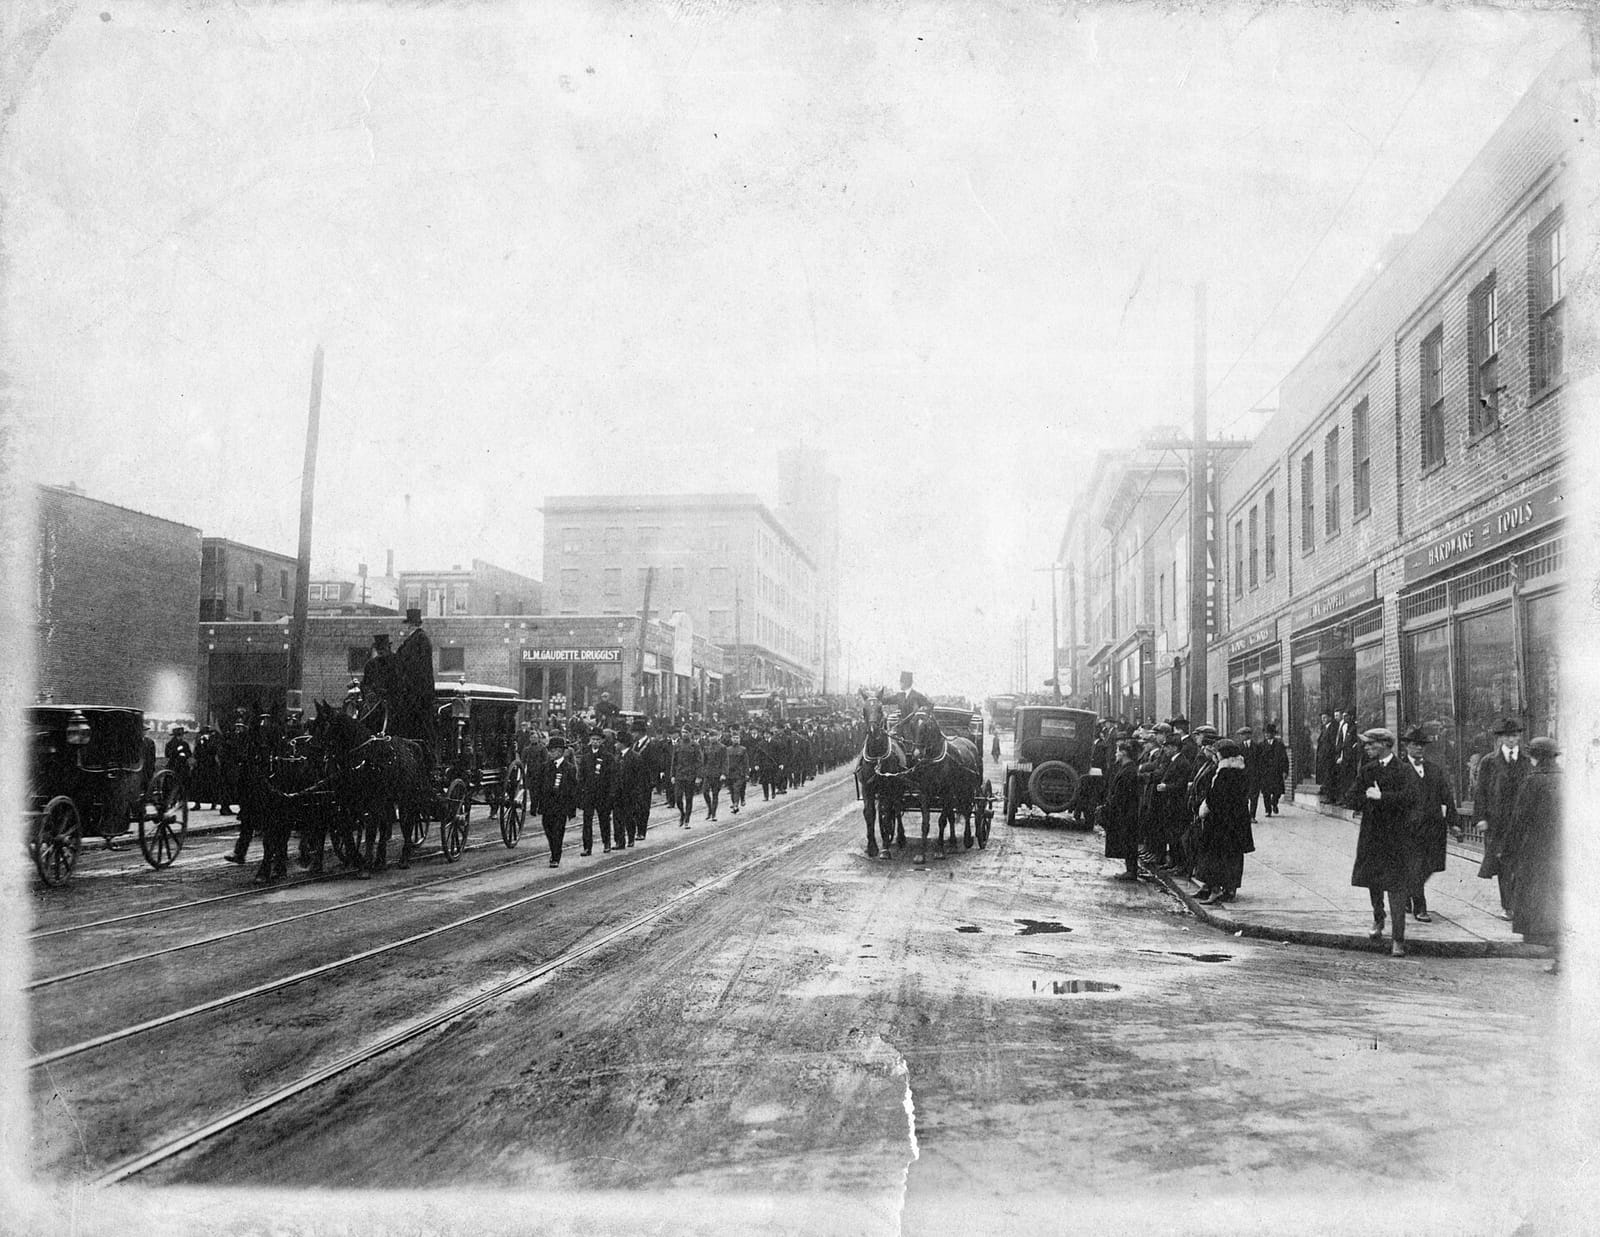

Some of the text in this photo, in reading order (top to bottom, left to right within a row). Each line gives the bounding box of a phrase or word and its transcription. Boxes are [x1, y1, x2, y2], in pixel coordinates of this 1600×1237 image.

[1428, 528, 1475, 566] HARDWARE
[1497, 501, 1533, 535] TOOLS
[580, 649, 620, 660] DRUGGIST
